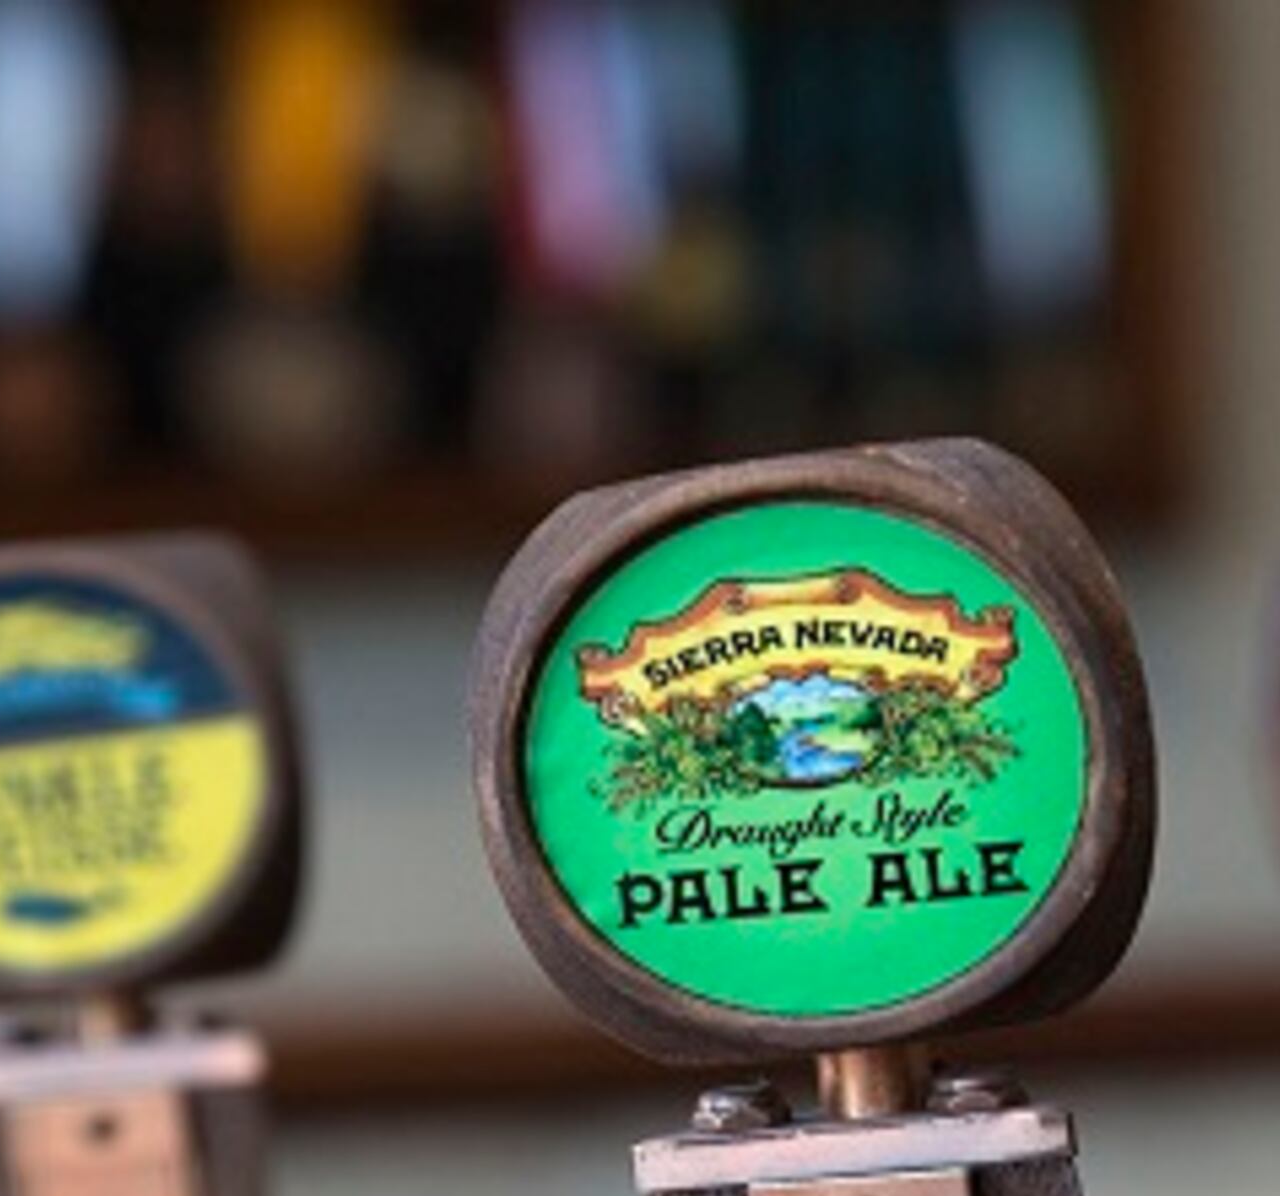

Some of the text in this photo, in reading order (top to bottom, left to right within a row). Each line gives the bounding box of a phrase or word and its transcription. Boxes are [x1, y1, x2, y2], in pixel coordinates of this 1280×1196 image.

[642, 618, 952, 692] SIERRA NEVADA
[654, 788, 970, 860] Draught Style
[614, 842, 1032, 928] PALE ALE
